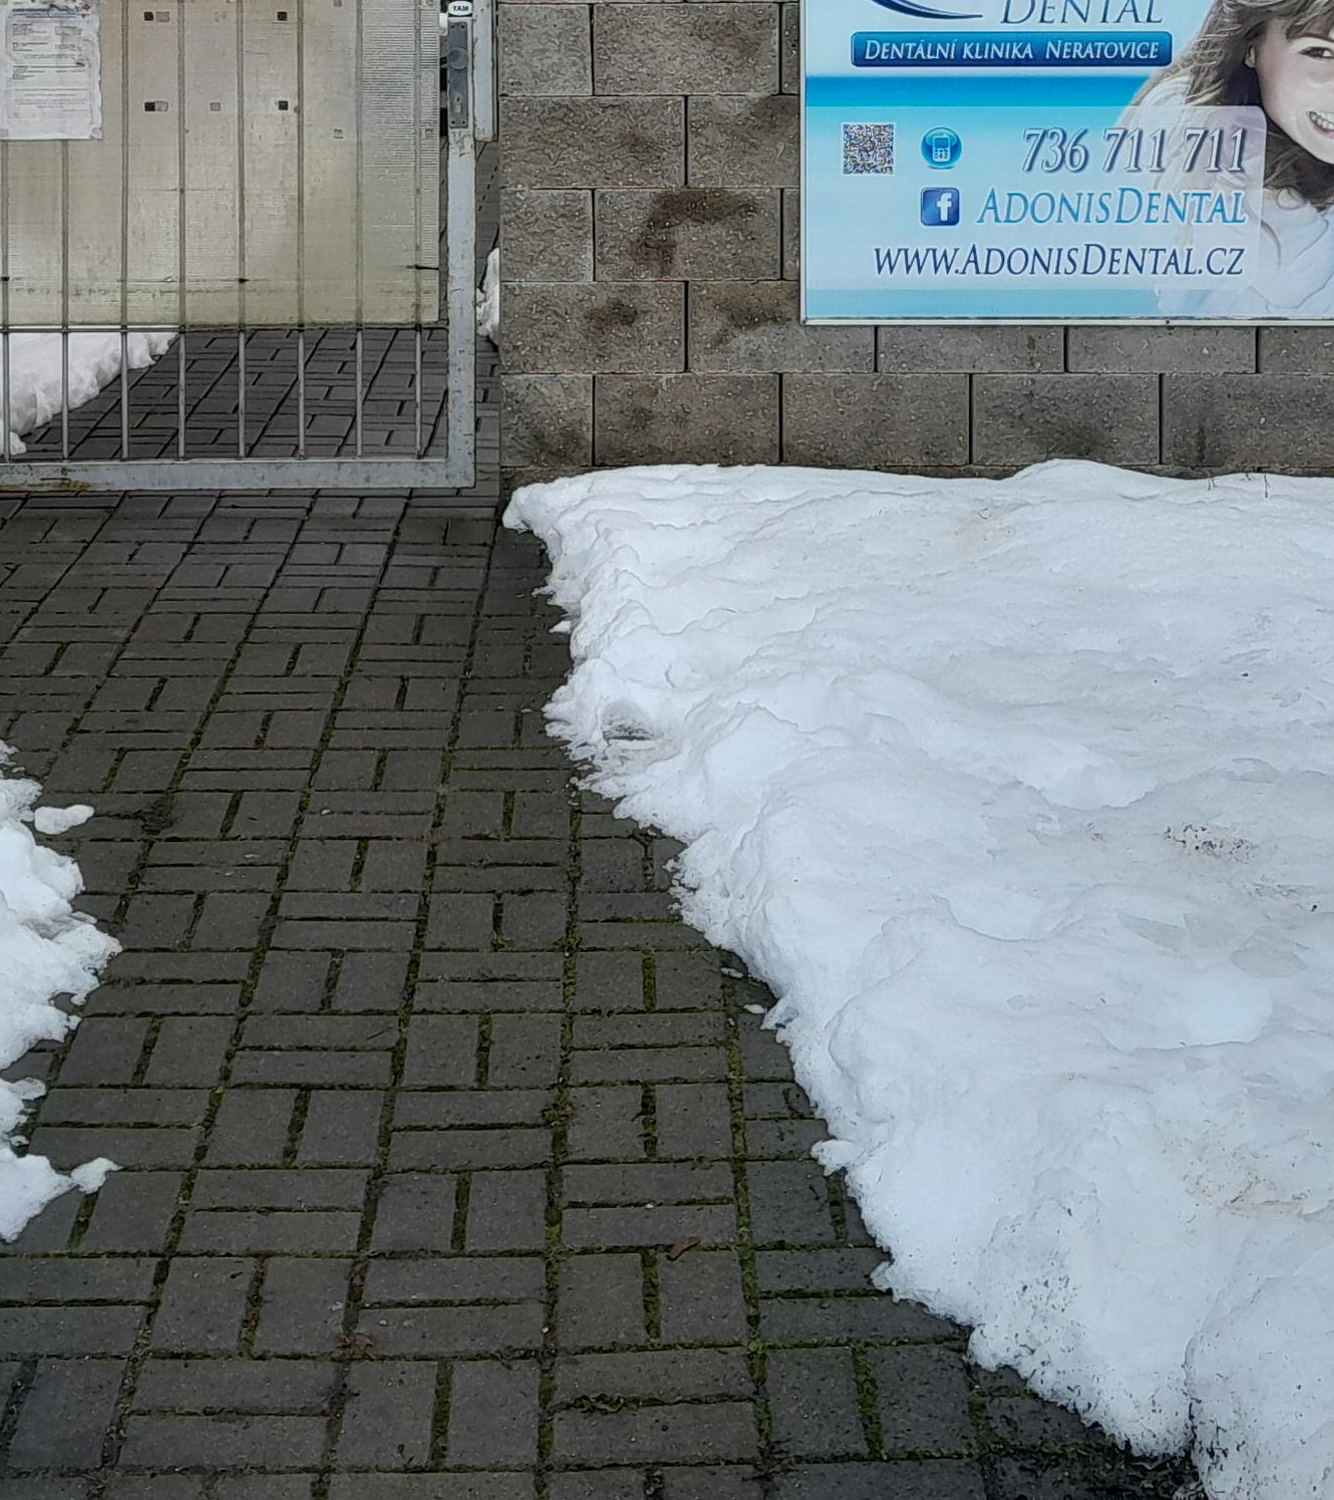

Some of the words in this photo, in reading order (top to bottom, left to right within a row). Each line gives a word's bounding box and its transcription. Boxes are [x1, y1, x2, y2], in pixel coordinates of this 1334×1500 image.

[865, 38, 958, 61] DENTÁLNÍ
[962, 40, 1034, 60] KLINIKA
[1045, 38, 1160, 61] NERATOVICE
[1021, 126, 1089, 174] 736
[1101, 127, 1167, 174] 711
[1182, 126, 1247, 174] 711
